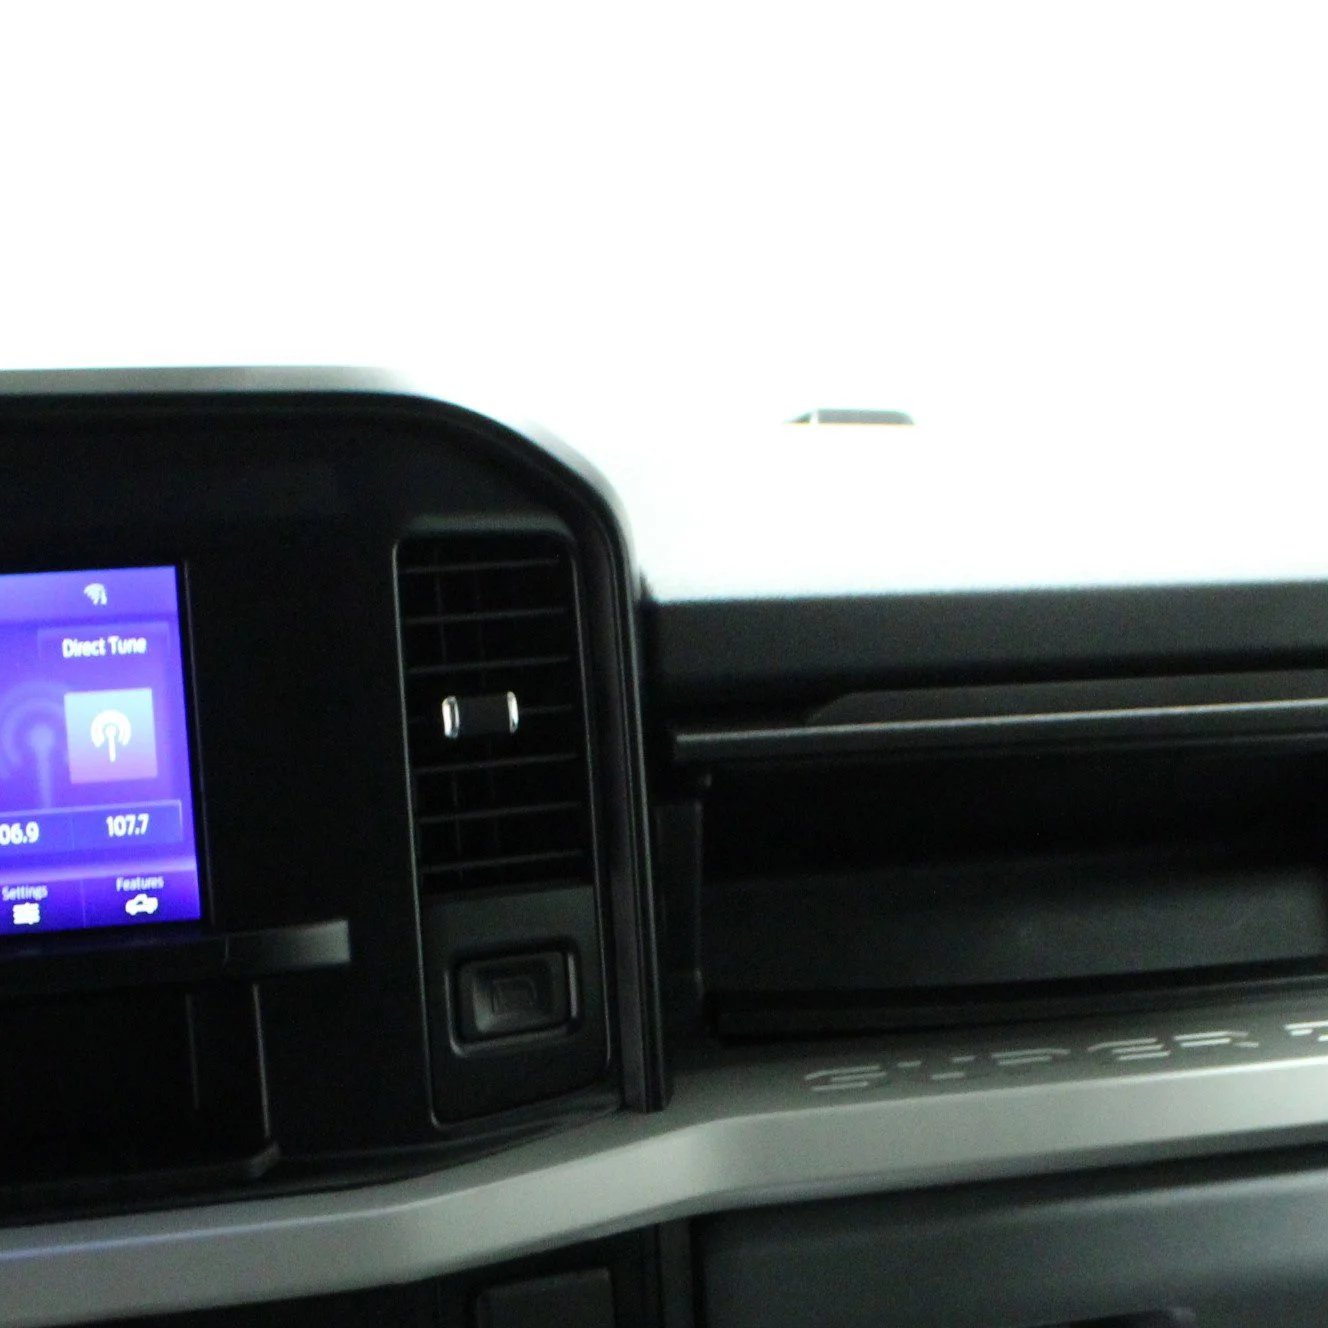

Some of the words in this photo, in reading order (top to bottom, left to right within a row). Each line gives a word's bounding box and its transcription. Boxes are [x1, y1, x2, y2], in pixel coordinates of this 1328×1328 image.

[62, 637, 106, 659] Direct
[108, 635, 147, 655] Tune
[106, 813, 149, 837] 107.7
[2, 885, 48, 901] Settings
[116, 876, 164, 892] Features
